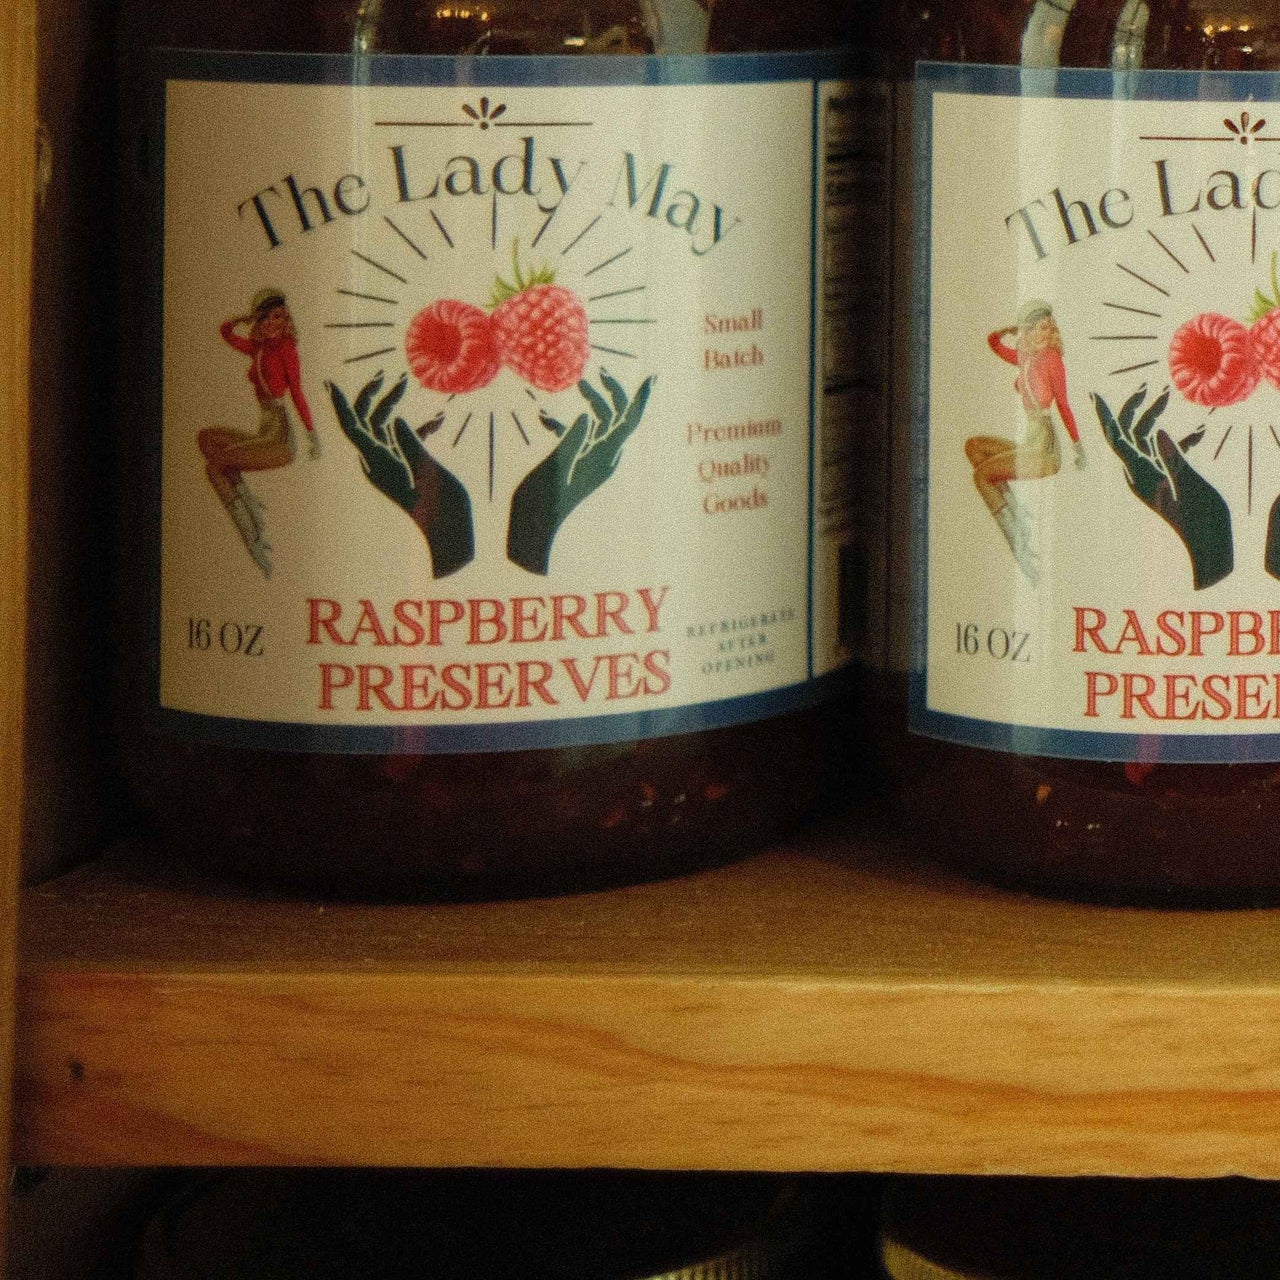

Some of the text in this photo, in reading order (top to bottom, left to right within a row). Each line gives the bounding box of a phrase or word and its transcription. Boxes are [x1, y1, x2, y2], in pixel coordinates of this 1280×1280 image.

[237, 135, 744, 257] The Lady May
[1004, 186, 1135, 262] The
[704, 308, 763, 333] Small
[704, 345, 764, 370] Batch
[688, 419, 782, 443] Premium
[697, 453, 769, 483] Quality
[703, 488, 768, 514] Goods
[306, 586, 670, 648] RASPBERRY
[187, 619, 265, 658] 16 OZ
[955, 622, 1032, 663] 16 OZ
[318, 650, 672, 711] PRESERVES
